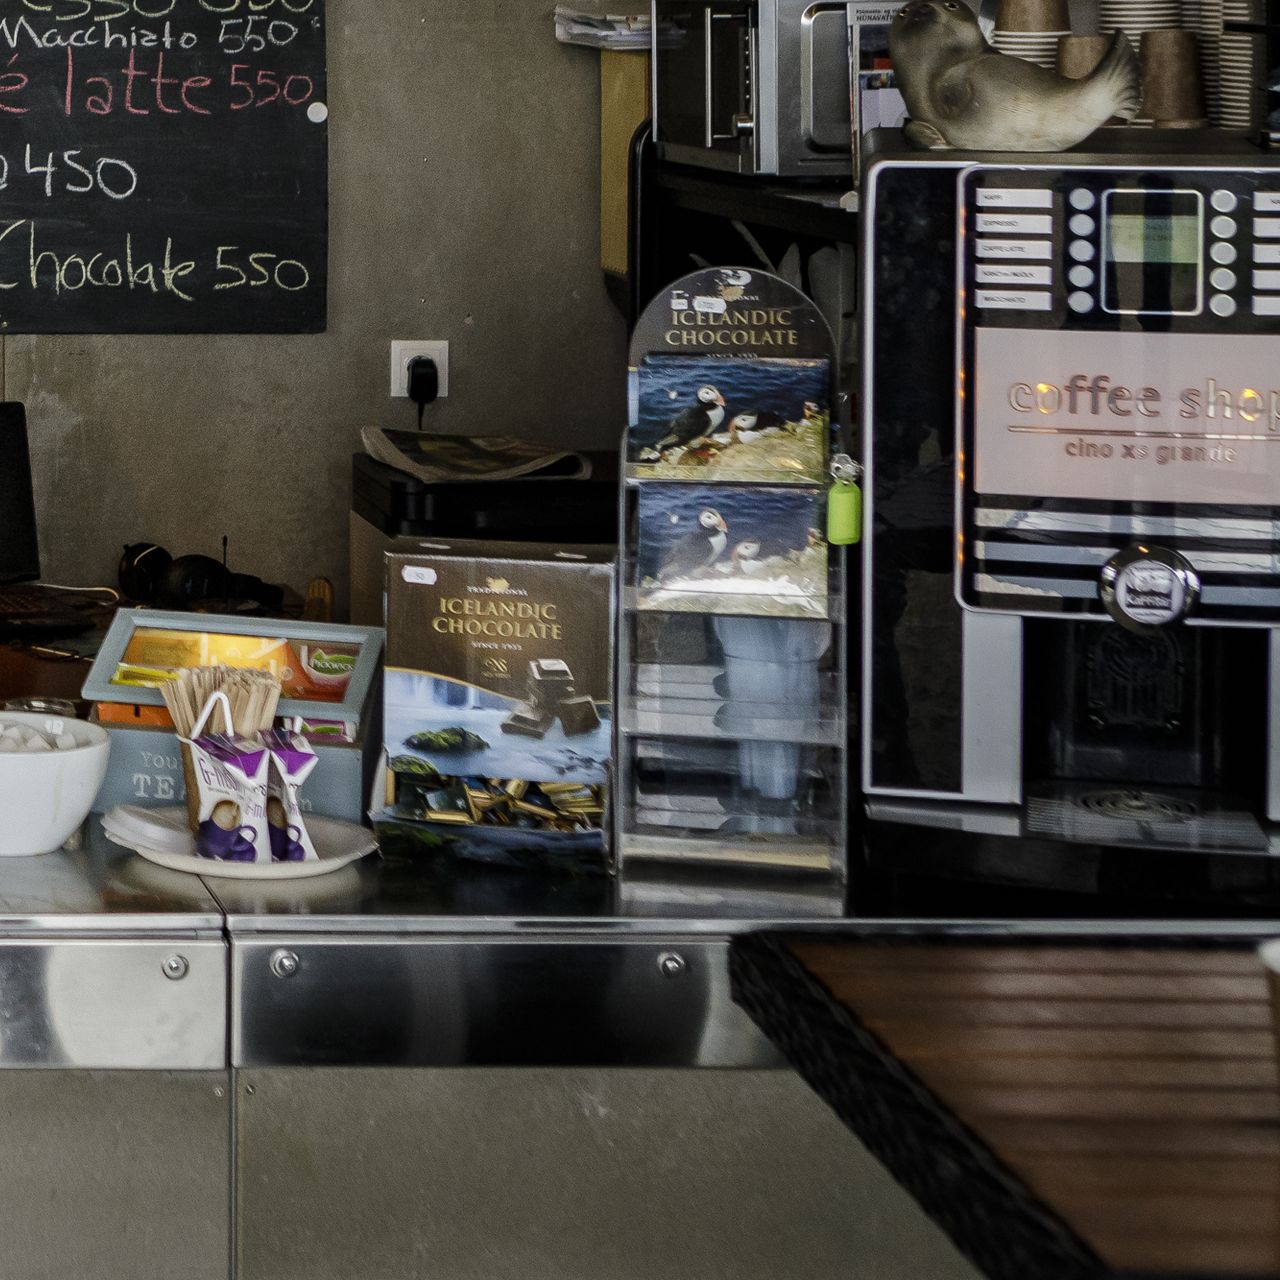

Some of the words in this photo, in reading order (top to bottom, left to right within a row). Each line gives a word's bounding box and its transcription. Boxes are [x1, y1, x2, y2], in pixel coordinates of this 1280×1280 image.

[217, 18, 298, 54] 550
[65, 46, 212, 115] latte
[228, 63, 314, 110] 550
[24, 149, 138, 200] 450
[213, 245, 311, 291] 550
[671, 309, 792, 326] ICELANDIC
[665, 329, 798, 346] CHOCOLATE
[1007, 374, 1161, 418] coffee
[1064, 437, 1114, 459] cino
[1156, 442, 1238, 465] grande
[440, 597, 557, 620] ICELANDIC
[432, 617, 562, 640] CHOCOLATE
[132, 773, 185, 800] TE
